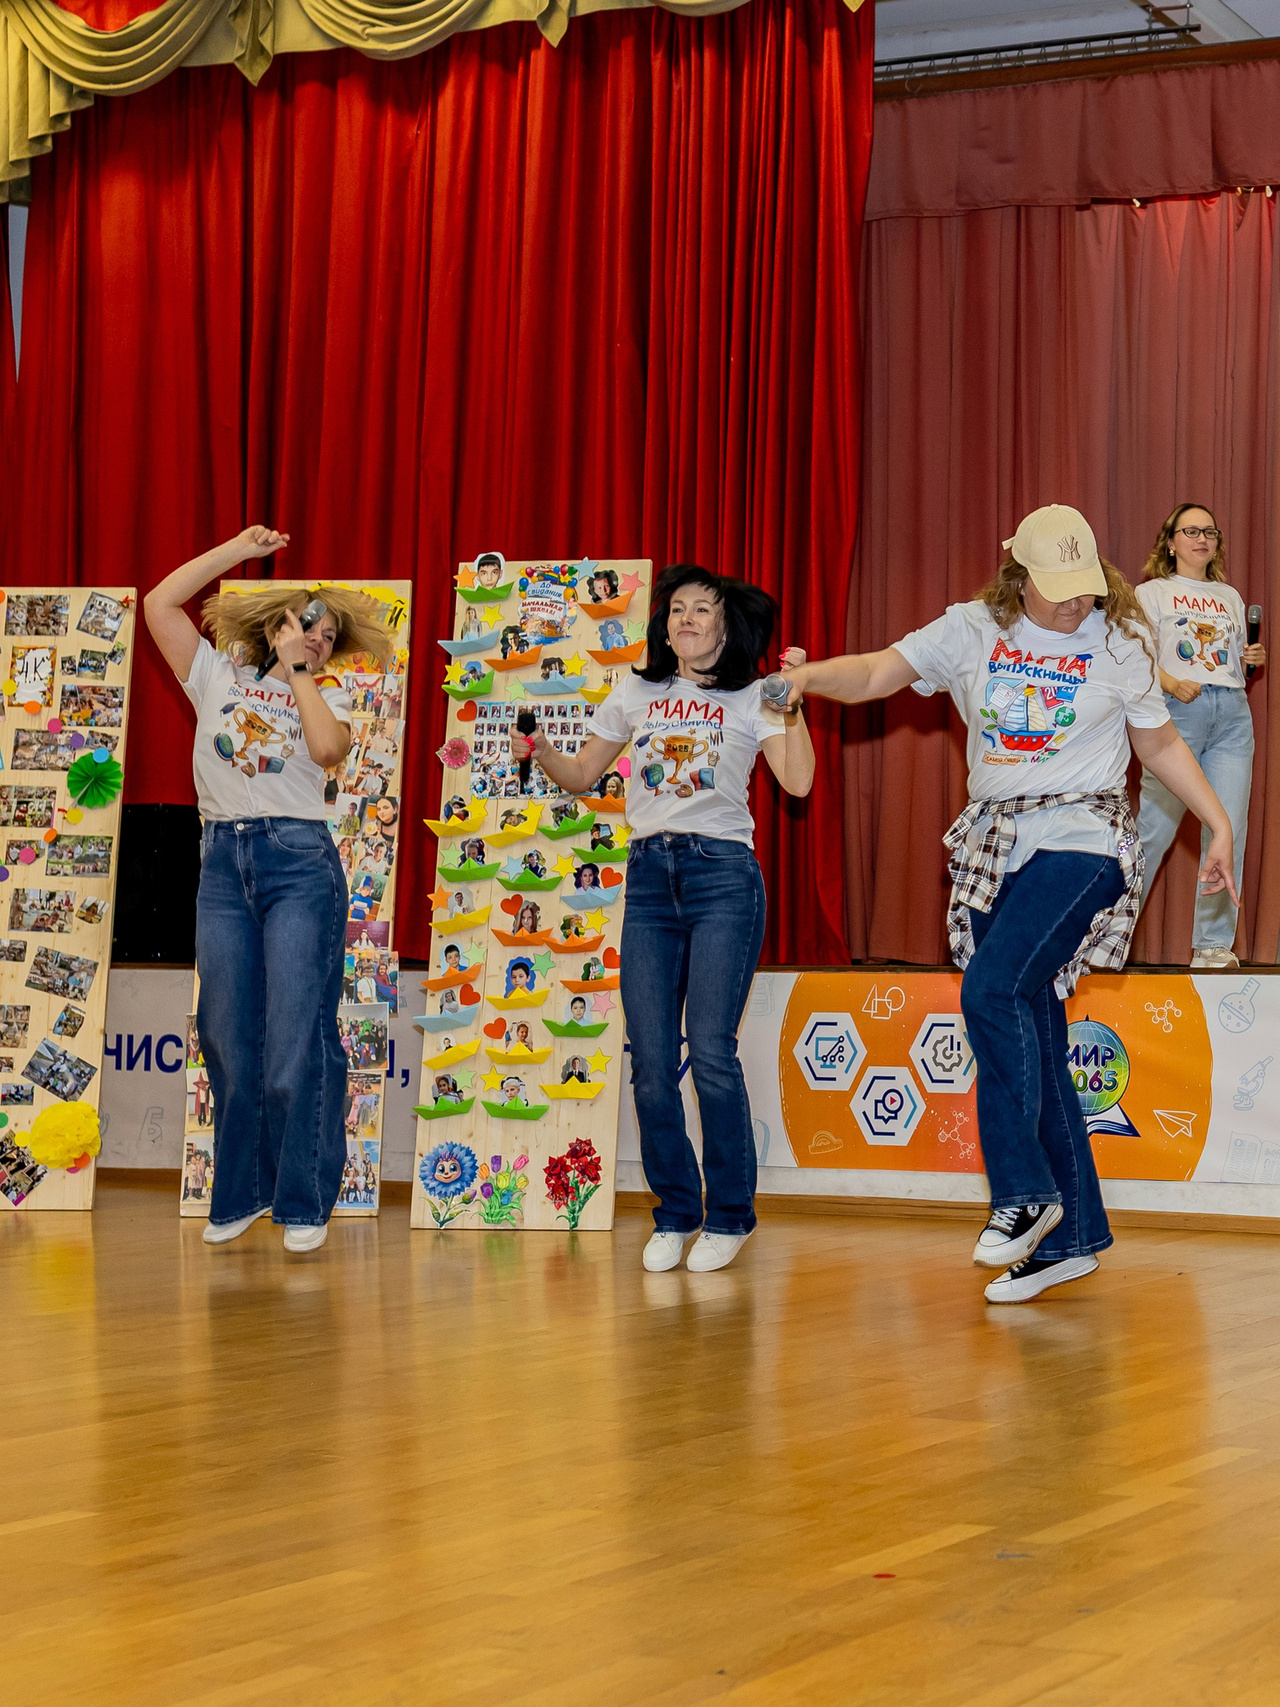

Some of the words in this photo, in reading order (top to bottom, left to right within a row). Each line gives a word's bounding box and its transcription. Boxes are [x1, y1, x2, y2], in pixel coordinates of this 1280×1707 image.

[1057, 534, 1081, 563] NY
[1173, 594, 1229, 614] МАМА
[647, 698, 724, 724] МАМА
[666, 743, 689, 752] 2025
[1073, 1070, 1118, 1093] 065
